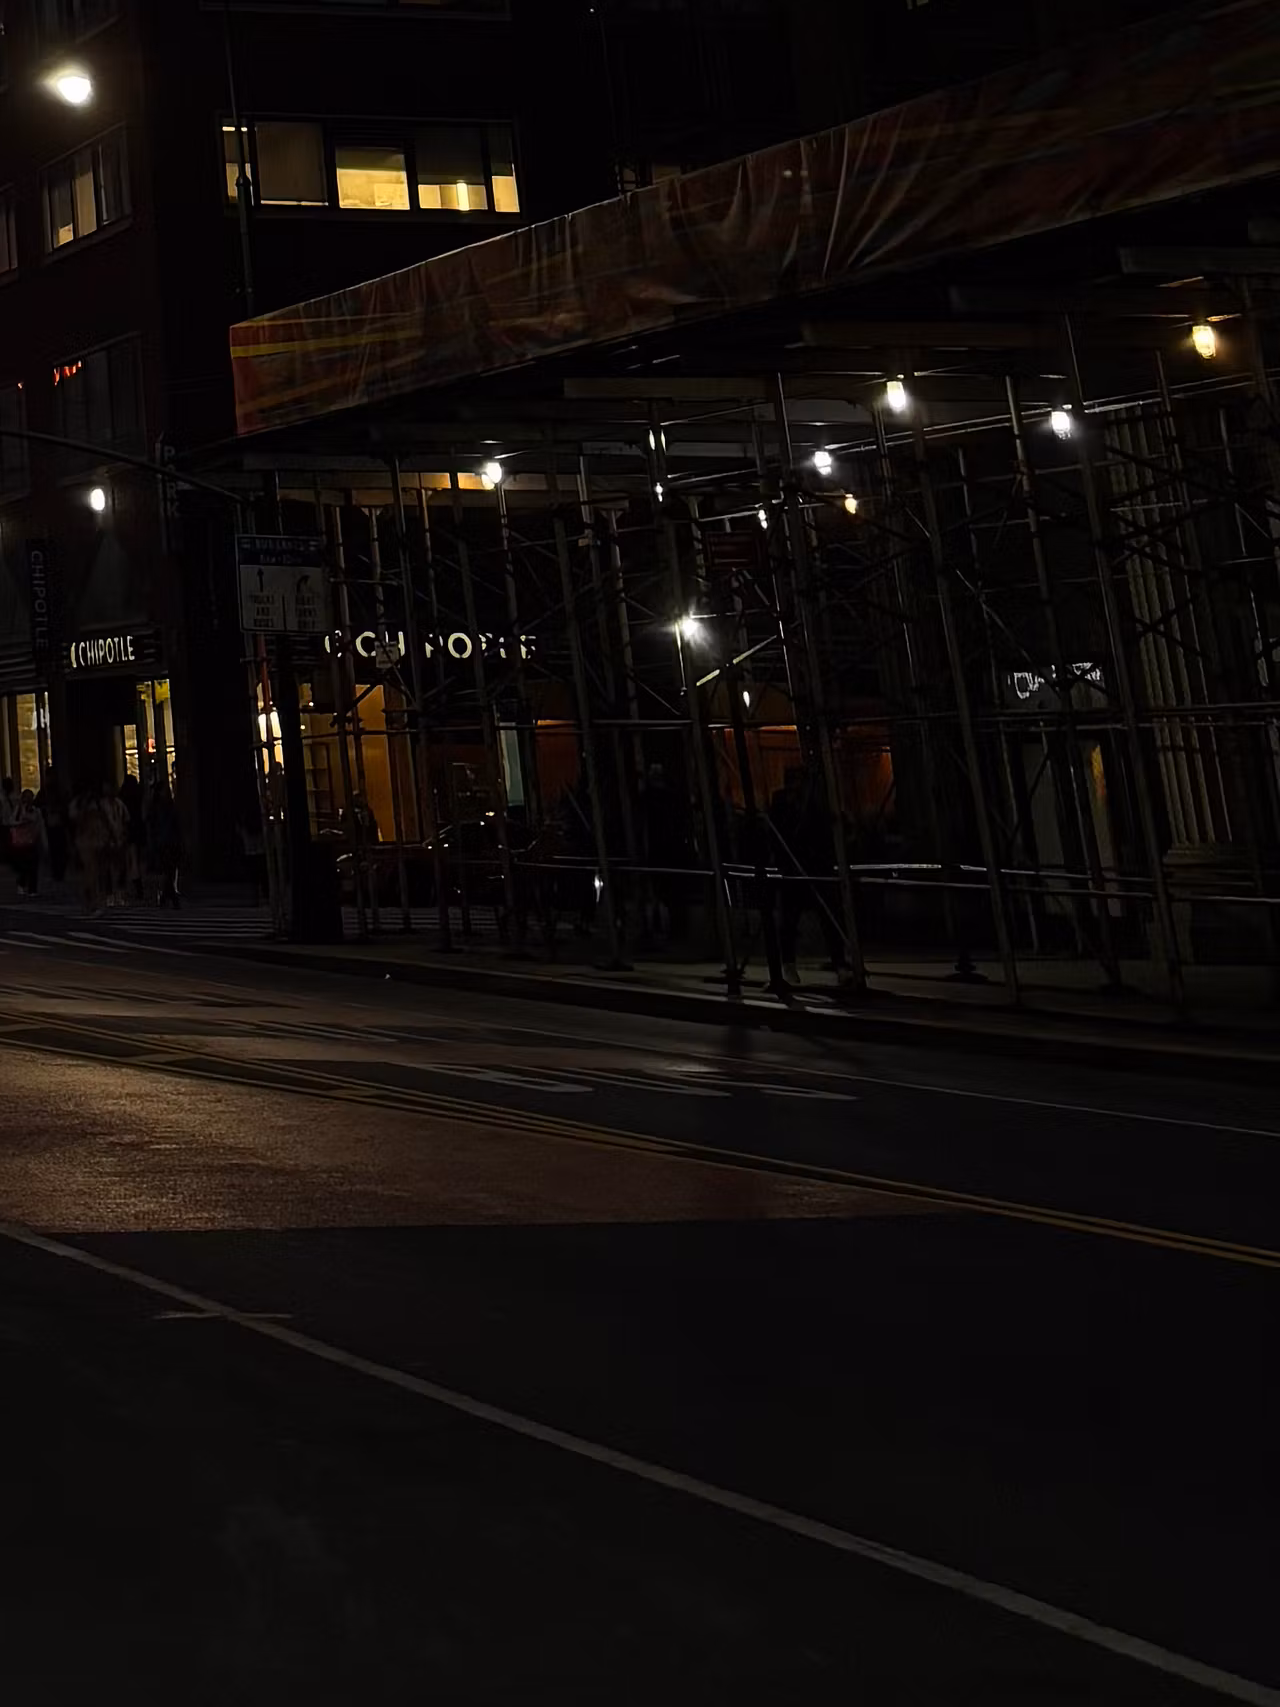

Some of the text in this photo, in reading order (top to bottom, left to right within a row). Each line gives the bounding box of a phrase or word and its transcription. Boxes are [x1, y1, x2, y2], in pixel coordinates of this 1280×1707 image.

[32, 550, 50, 651] CHIPOTLE
[78, 635, 136, 667] CHIPOTLE
[355, 630, 537, 659] CHPOE
